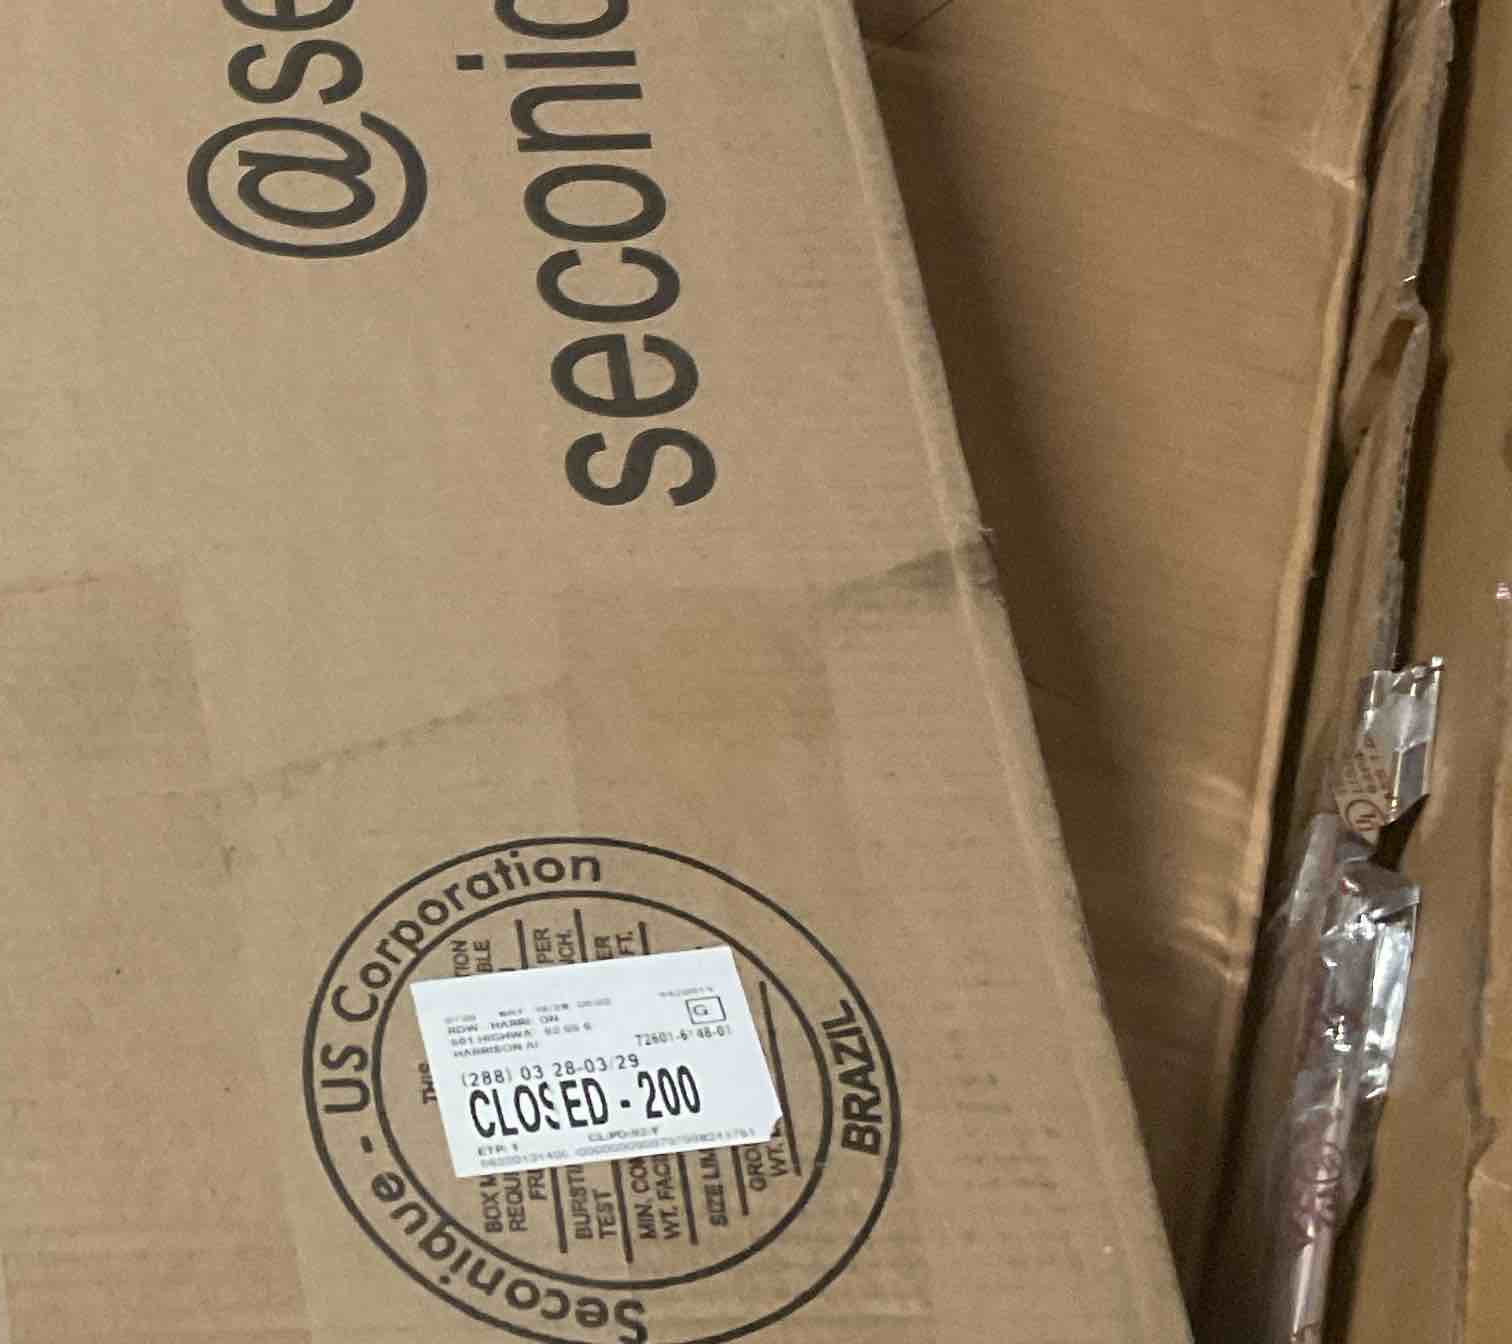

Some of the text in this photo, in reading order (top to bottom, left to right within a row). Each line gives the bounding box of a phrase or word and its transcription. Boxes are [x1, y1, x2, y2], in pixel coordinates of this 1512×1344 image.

[332, 849, 600, 1023] Corporation
[594, 935, 613, 960] ER
[320, 1043, 370, 1114] US
[468, 1076, 610, 1139] CLOSED
[638, 1064, 702, 1120] 200
[816, 998, 882, 1157] BRAZIL
[481, 1190, 503, 1233] BOX
[592, 1188, 617, 1239] TEST
[372, 1172, 648, 1344] Seconique
